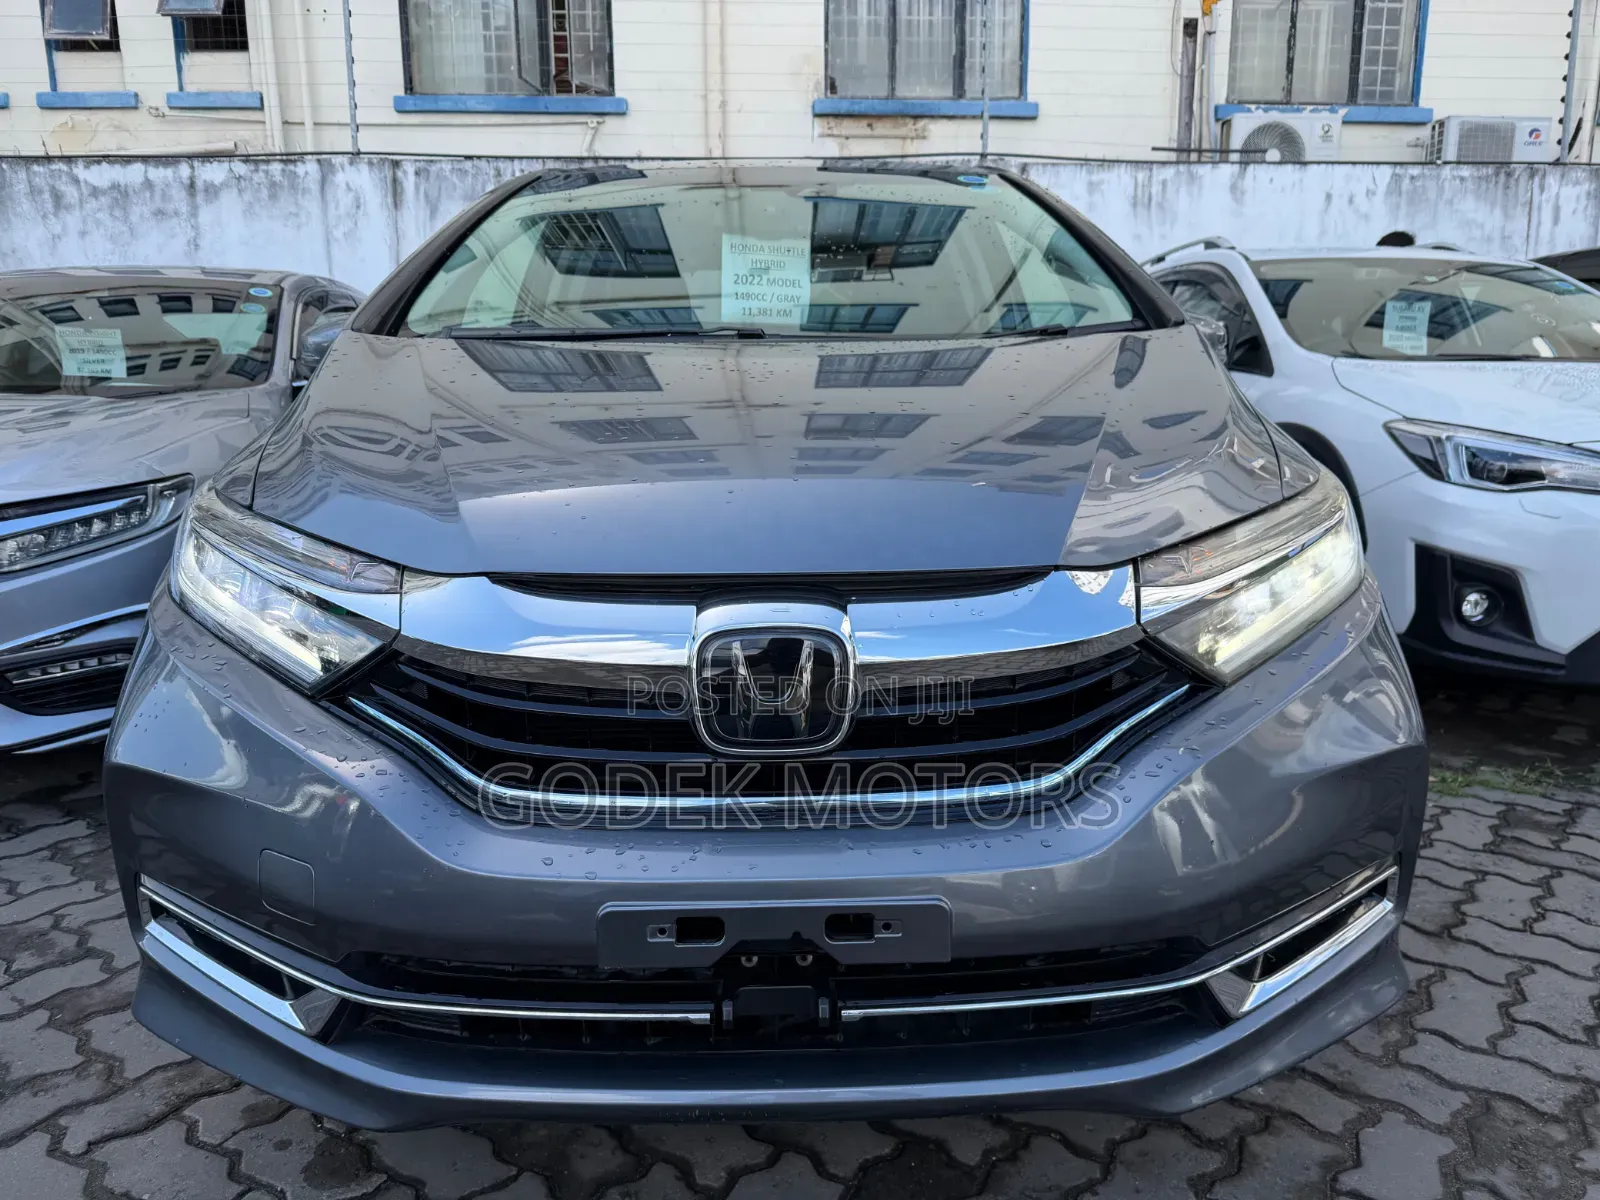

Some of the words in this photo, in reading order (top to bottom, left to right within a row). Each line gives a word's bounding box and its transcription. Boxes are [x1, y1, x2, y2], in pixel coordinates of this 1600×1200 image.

[730, 242, 765, 253] HONDA
[767, 244, 806, 256] SHUTTLE
[751, 258, 786, 269] HYBRID
[733, 273, 764, 286] 2022
[766, 277, 803, 288] MODEL
[734, 292, 768, 302] 1490CC
[769, 292, 775, 303] /
[776, 294, 802, 303] GRAY
[741, 306, 773, 318] 11,381
[776, 308, 793, 318] KM
